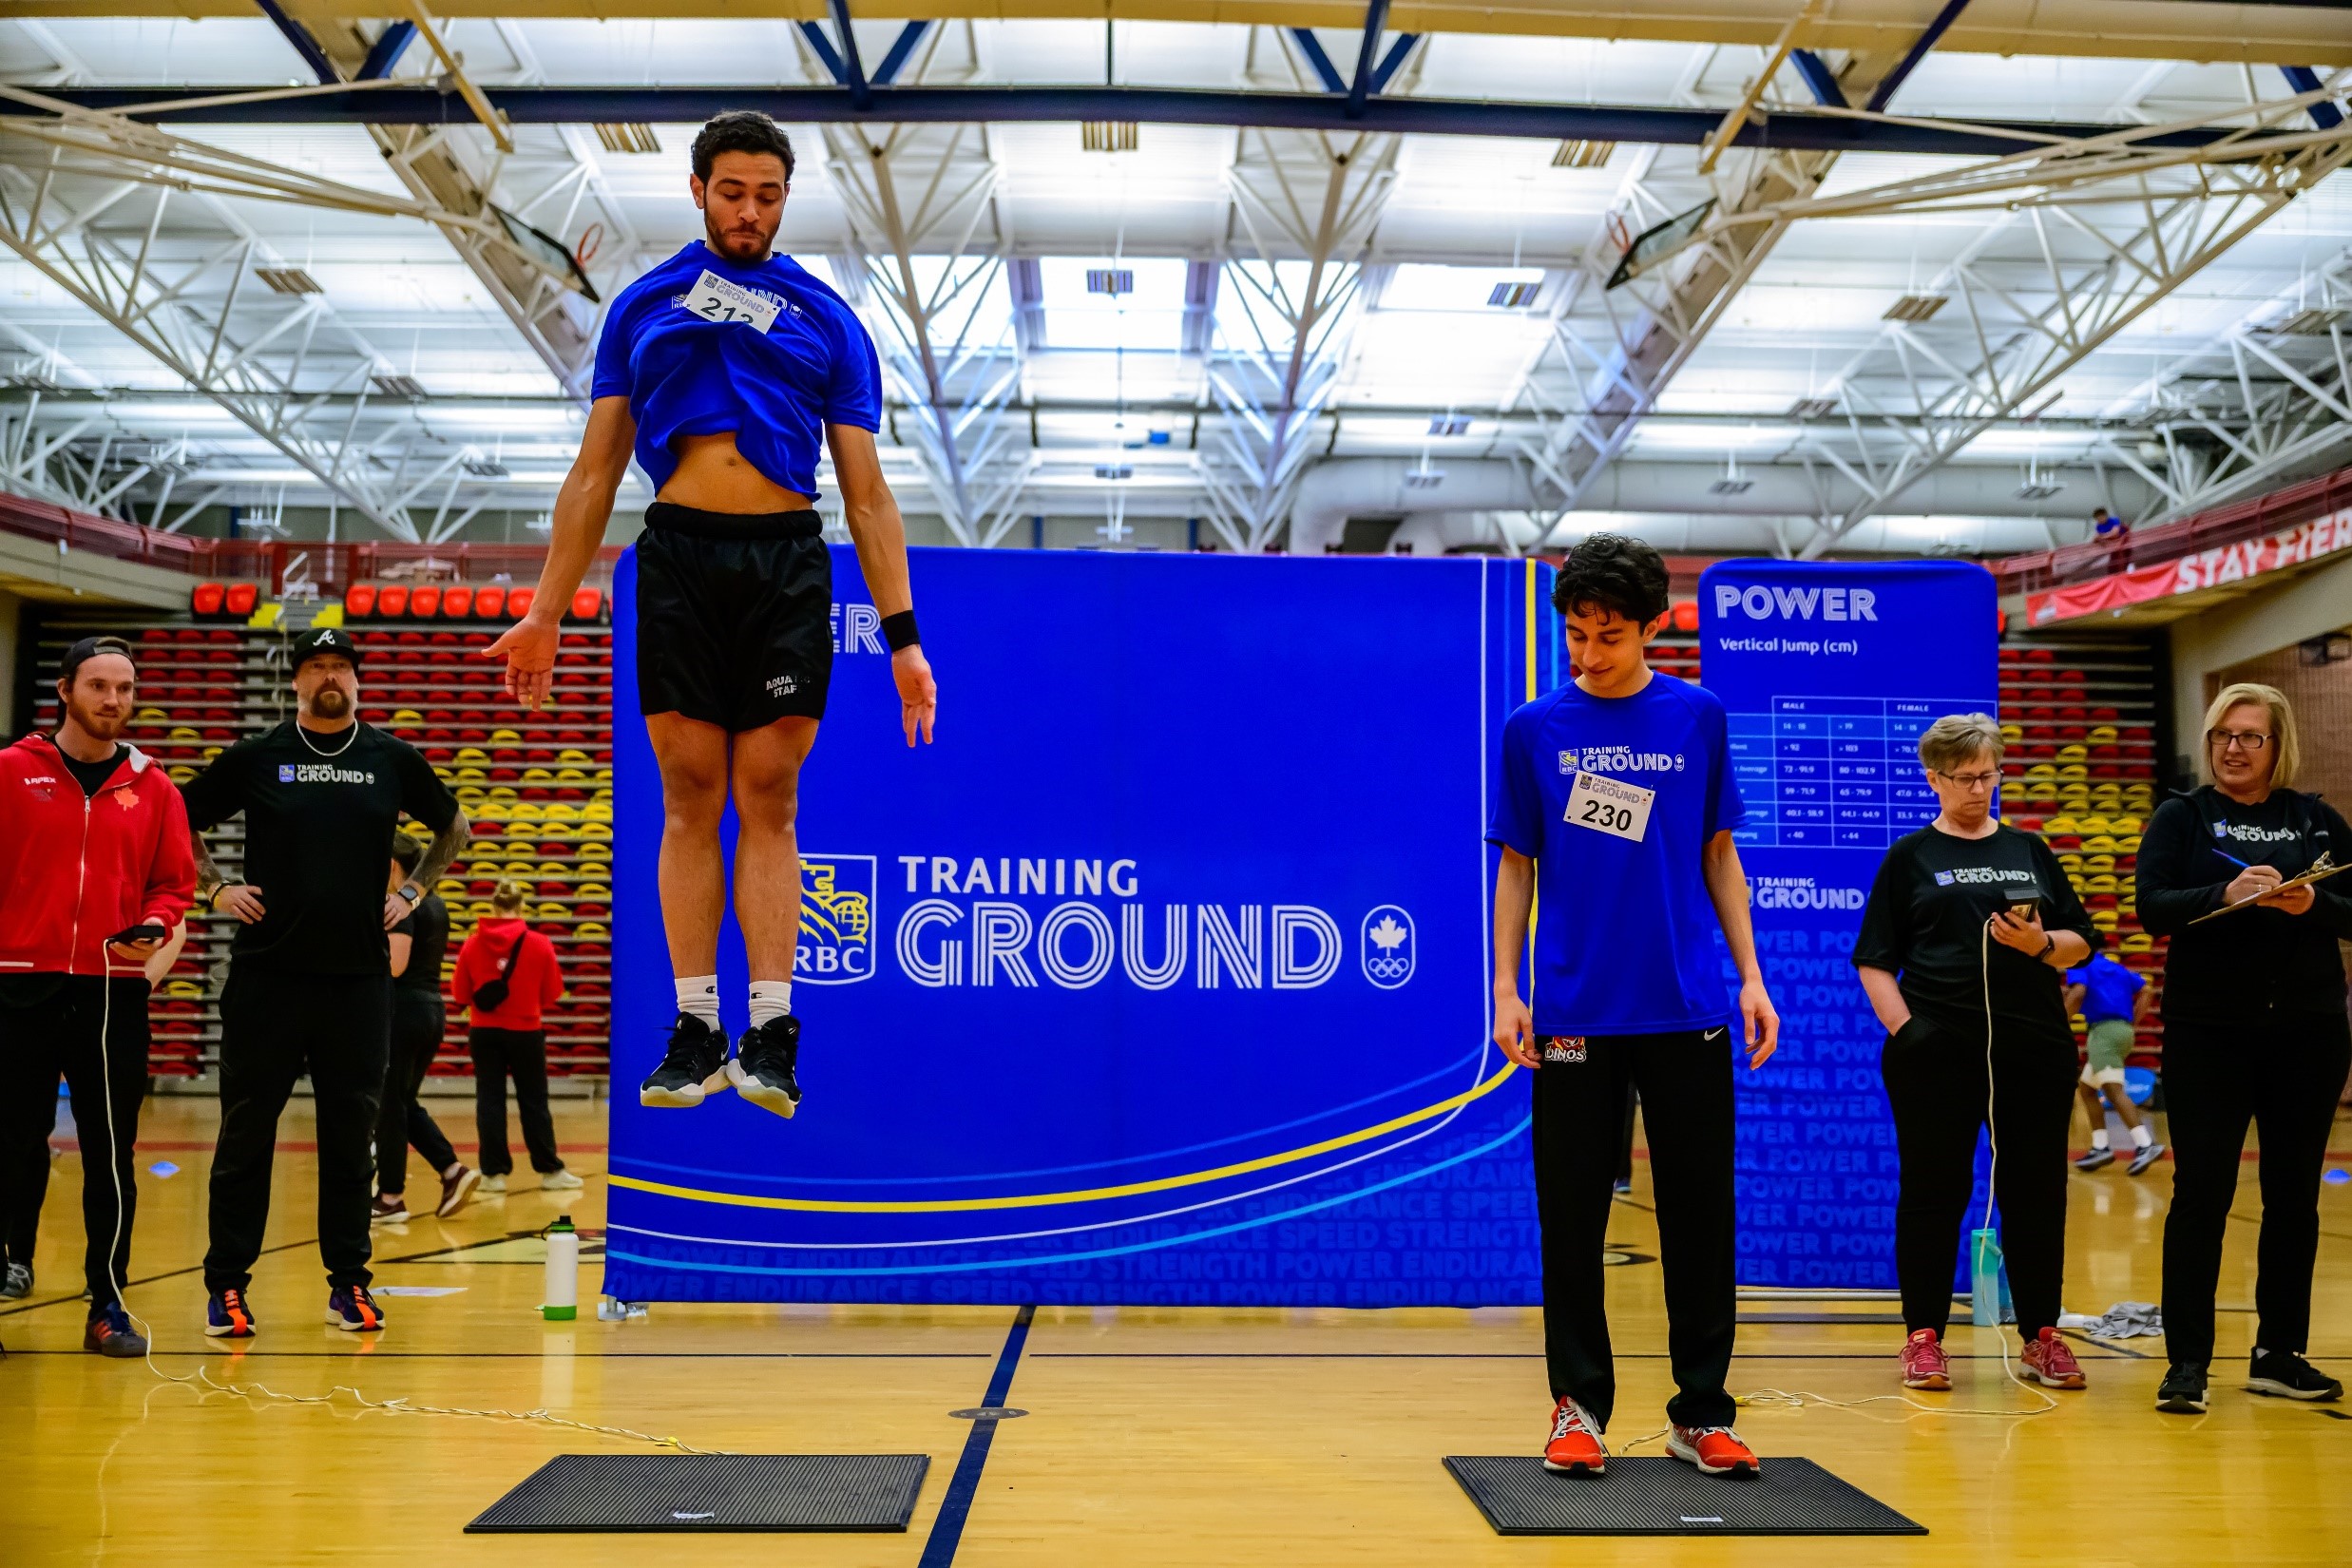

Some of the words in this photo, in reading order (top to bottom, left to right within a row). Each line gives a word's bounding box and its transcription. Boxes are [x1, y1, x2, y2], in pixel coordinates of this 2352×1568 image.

[716, 284, 765, 314] GROUND
[720, 280, 747, 296] TRAINING
[2173, 538, 2266, 594] STAY
[1715, 584, 1879, 622] POWER
[1719, 638, 1778, 652] Vertical
[1782, 639, 1820, 656] Jump
[1824, 639, 1859, 656] (cm)
[1897, 704, 1929, 713] FEMALE
[1582, 745, 1631, 755] TRAINING
[1581, 754, 1673, 773] GROUND
[296, 770, 365, 784] GROUND
[1595, 777, 1620, 789] TRAINING
[1592, 782, 1640, 804] GROUND
[1580, 799, 1633, 832] 230
[898, 856, 1138, 896] TRAINING
[1757, 877, 1815, 888] TRAINING
[1956, 870, 2030, 884] GROUND
[1757, 888, 1865, 910] GROUND
[895, 898, 1343, 990] GROUND
[793, 947, 865, 973] RBC
[1544, 1048, 1586, 1061] DINOS
[1781, 1094, 1882, 1118] POWER
[1769, 1148, 1869, 1172] POWER
[1734, 1175, 1834, 1199] POWER
[1277, 1221, 1380, 1250] SPEED
[1098, 1252, 1267, 1280] STRENGTH
[1276, 1252, 1393, 1280] POWER
[1788, 1260, 1889, 1284] POWER
[715, 1274, 921, 1303] ENDURANCE
[930, 1279, 1034, 1304] SPEED
[1042, 1281, 1210, 1304] STRENGTH
[1219, 1281, 1336, 1305] POWER
